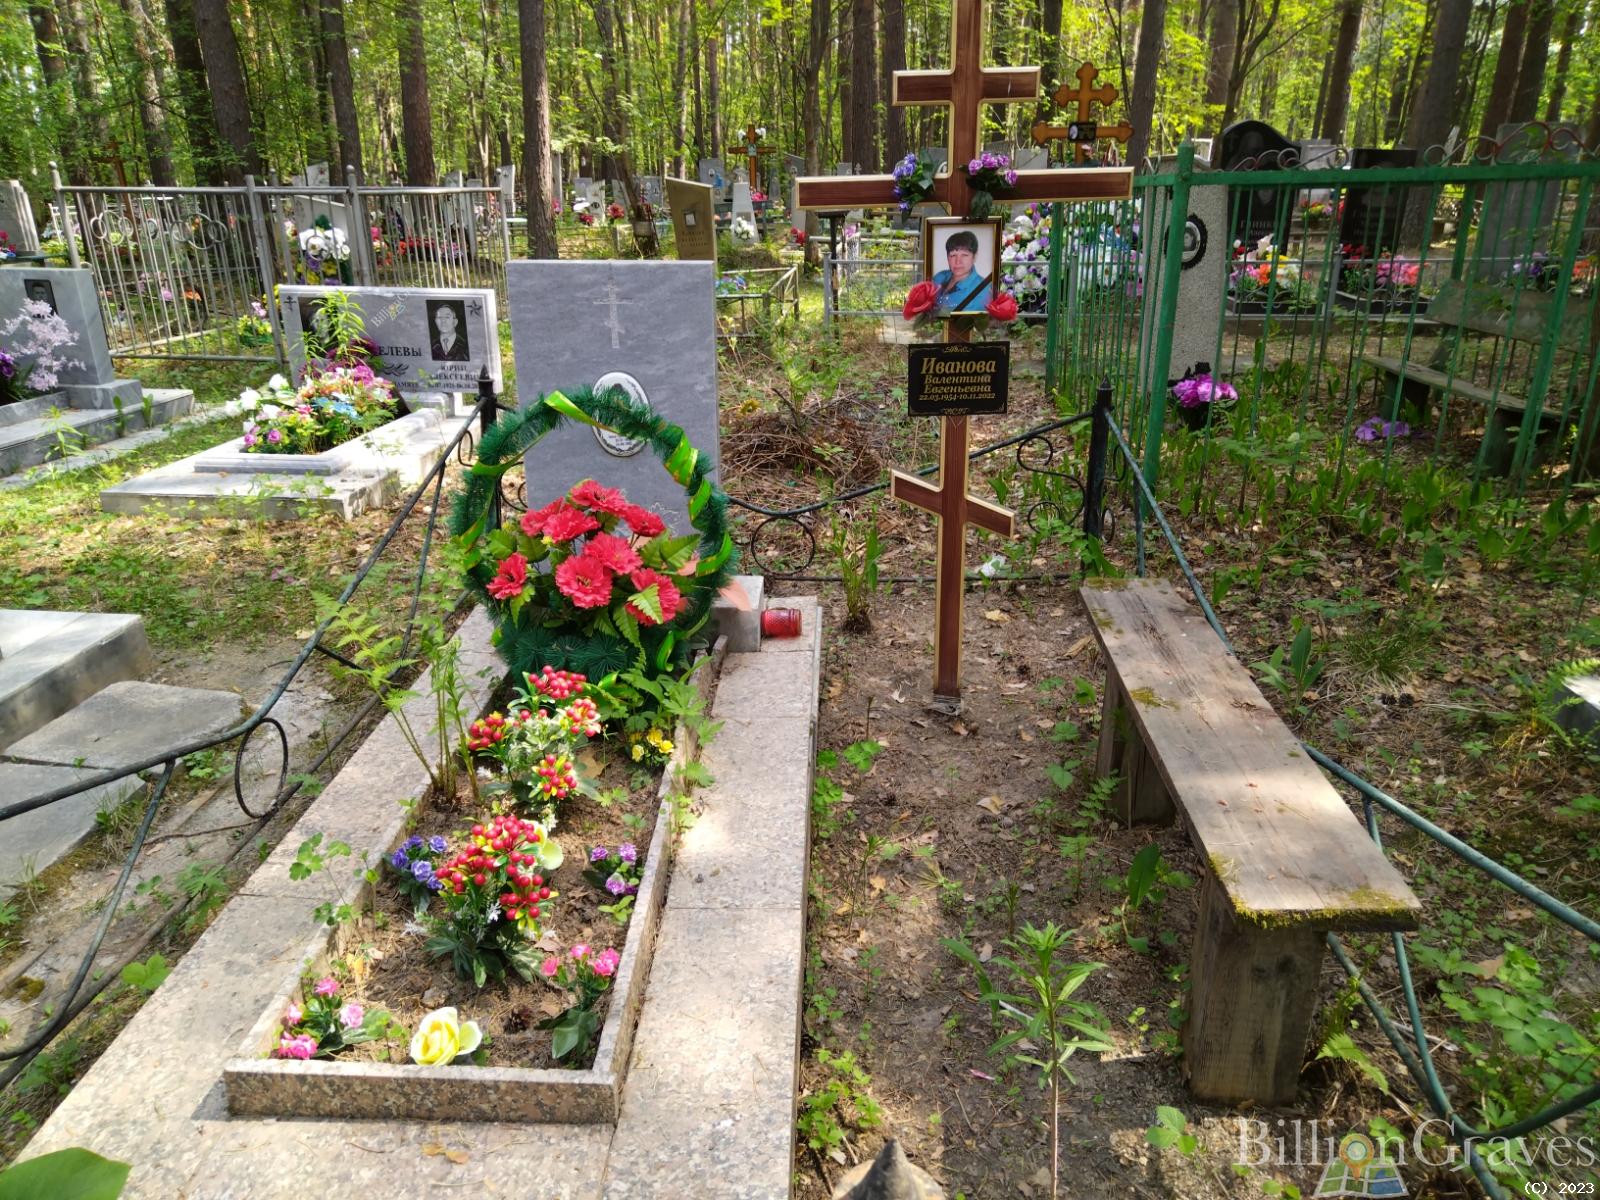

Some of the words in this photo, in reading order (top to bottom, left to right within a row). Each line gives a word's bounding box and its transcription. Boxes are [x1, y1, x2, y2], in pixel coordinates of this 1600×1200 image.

[378, 345, 422, 357] ЕЛЕВЫ
[920, 357, 997, 375] Иванова
[923, 374, 992, 384] Валентина
[923, 384, 992, 394] Евгеньевна
